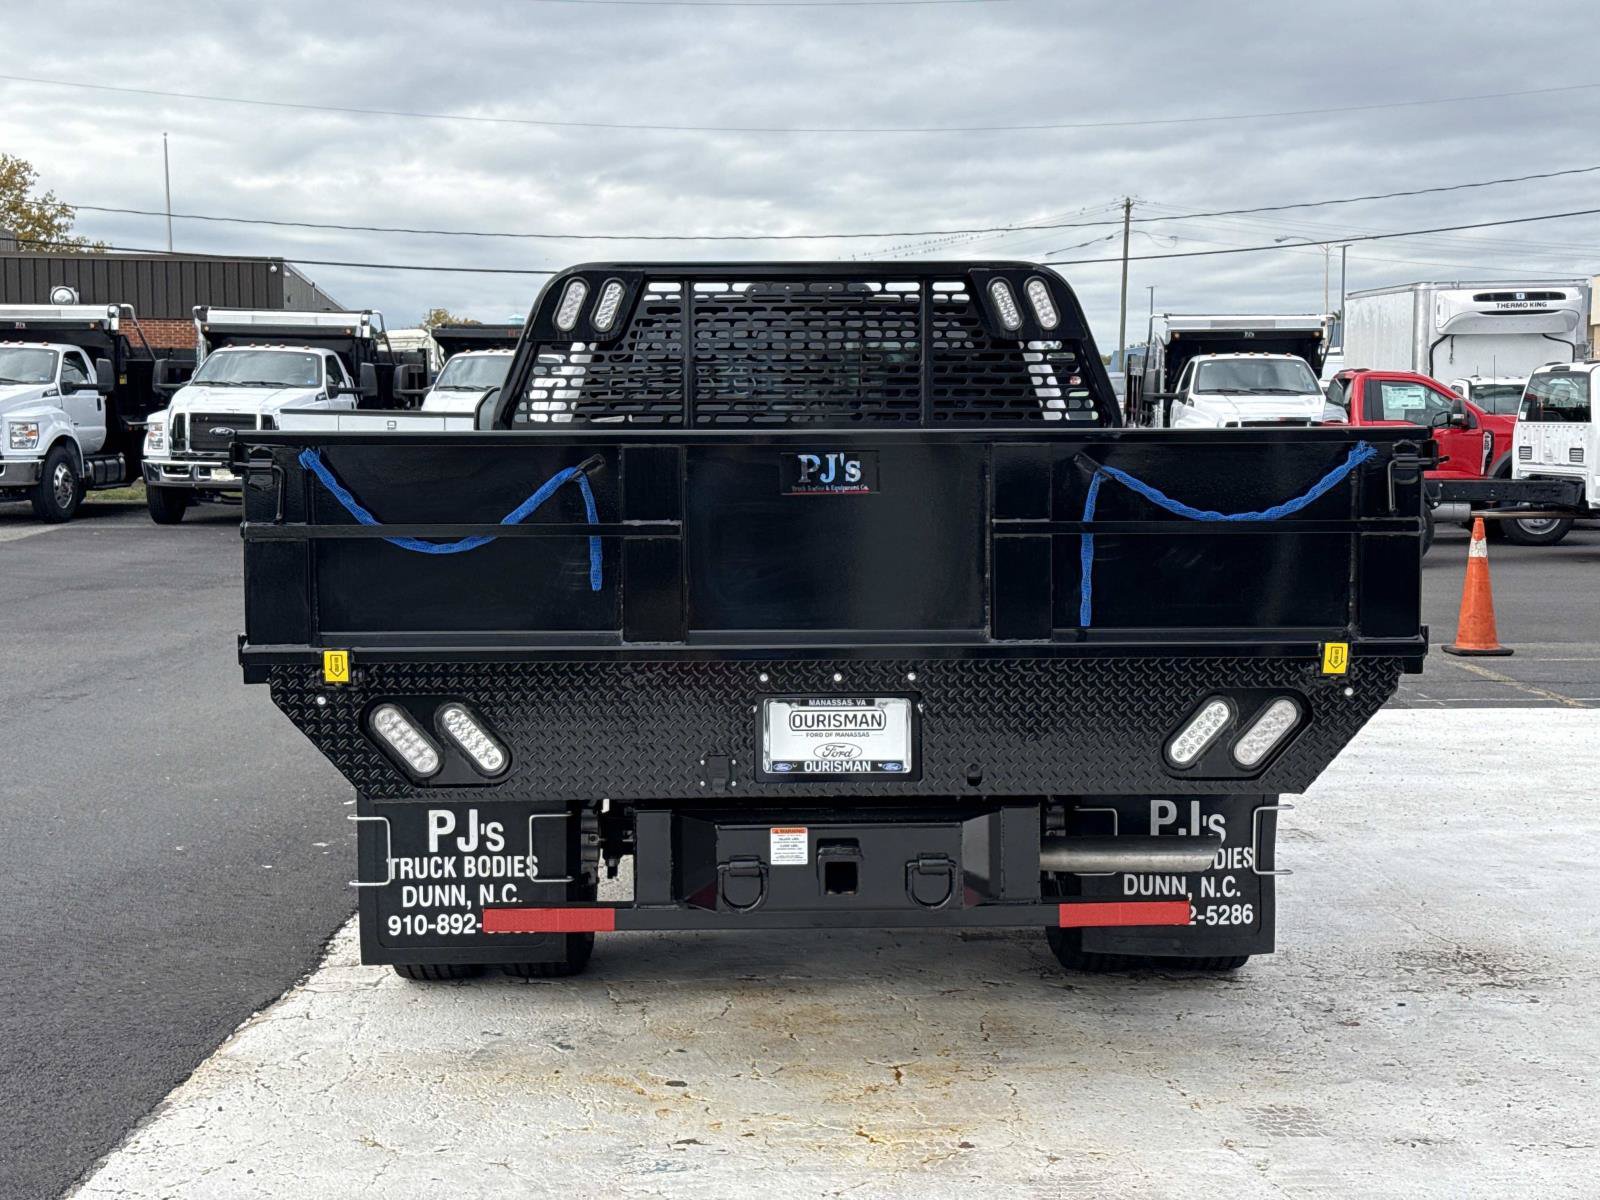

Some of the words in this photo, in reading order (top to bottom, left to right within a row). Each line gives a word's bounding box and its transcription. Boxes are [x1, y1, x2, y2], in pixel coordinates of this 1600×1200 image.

[797, 452, 861, 482] PJ's
[792, 713, 882, 728] OURISMAN
[822, 744, 853, 758] Ford
[804, 760, 871, 772] OURISMAN
[428, 809, 505, 853] PJ's
[386, 855, 457, 880] TRUCK
[464, 855, 539, 878] BODIES
[1208, 847, 1253, 870] DIES
[402, 884, 472, 910] DUNN,
[480, 883, 523, 905] N.C.
[1123, 874, 1193, 901] DUNN,
[1201, 876, 1241, 898] N.C.
[388, 913, 534, 936] 910-892-
